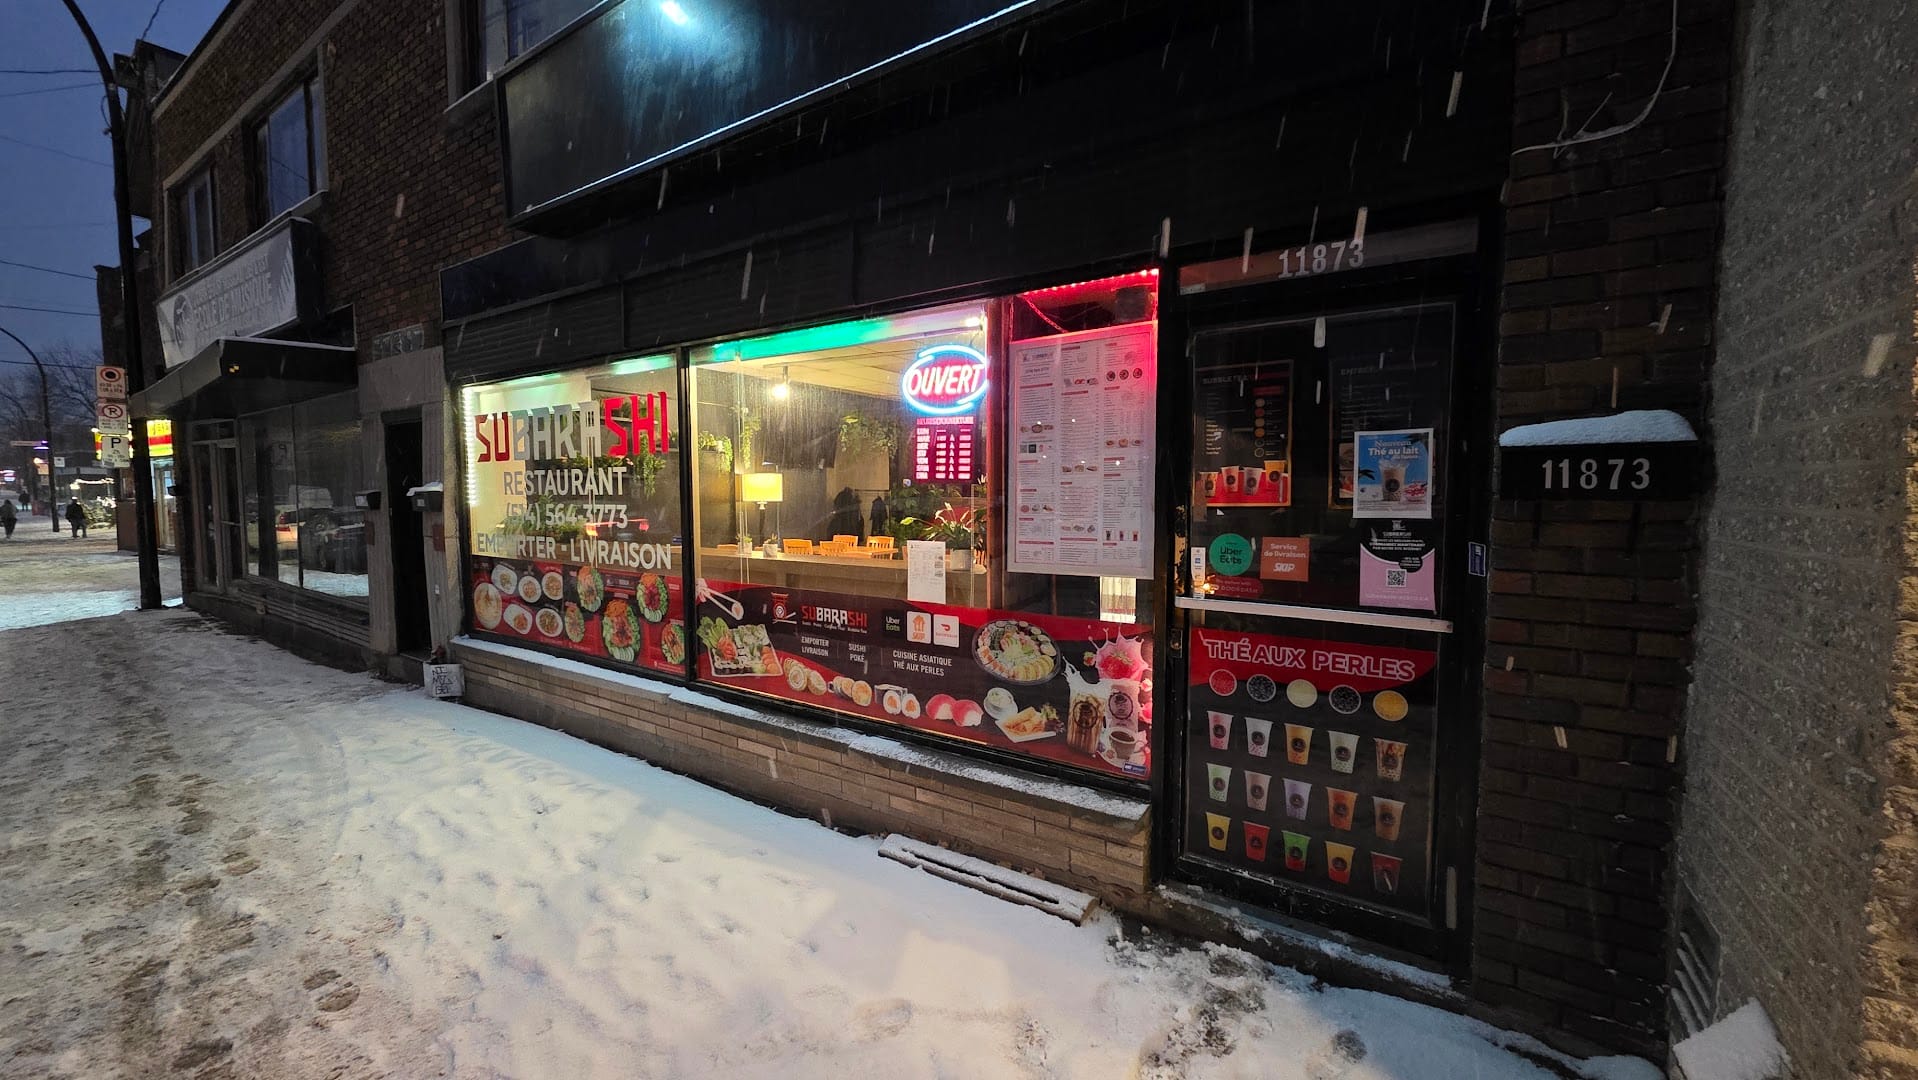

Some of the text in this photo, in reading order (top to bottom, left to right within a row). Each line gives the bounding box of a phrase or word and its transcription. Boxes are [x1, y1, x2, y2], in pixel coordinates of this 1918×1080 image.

[1278, 239, 1365, 280] 11873
[906, 364, 985, 396] OUVERT
[474, 391, 669, 463] SUBARASHI
[1368, 447, 1387, 456] Thé
[1402, 446, 1420, 455] lait
[504, 466, 627, 496] RESTAURANT
[1542, 458, 1650, 490] 11873
[546, 503, 628, 529] 564-3773
[477, 532, 672, 570] EMRTER LIVRAISON
[1219, 554, 1243, 565] Eats
[1220, 547, 1243, 555] Uber
[1274, 550, 1306, 558] livraison
[801, 605, 868, 628] SUBARASHI
[885, 616, 900, 624] Uber
[801, 636, 829, 647] EMPORTER
[848, 643, 866, 653] SUSHI
[801, 646, 829, 657] LIVRAISON
[849, 652, 865, 663] POKÉ
[893, 650, 953, 667] CUISINE ASIATIQUE
[1203, 637, 1416, 682] THÉ AUX PERLES
[893, 659, 945, 677] THÉ AUX PERLES
